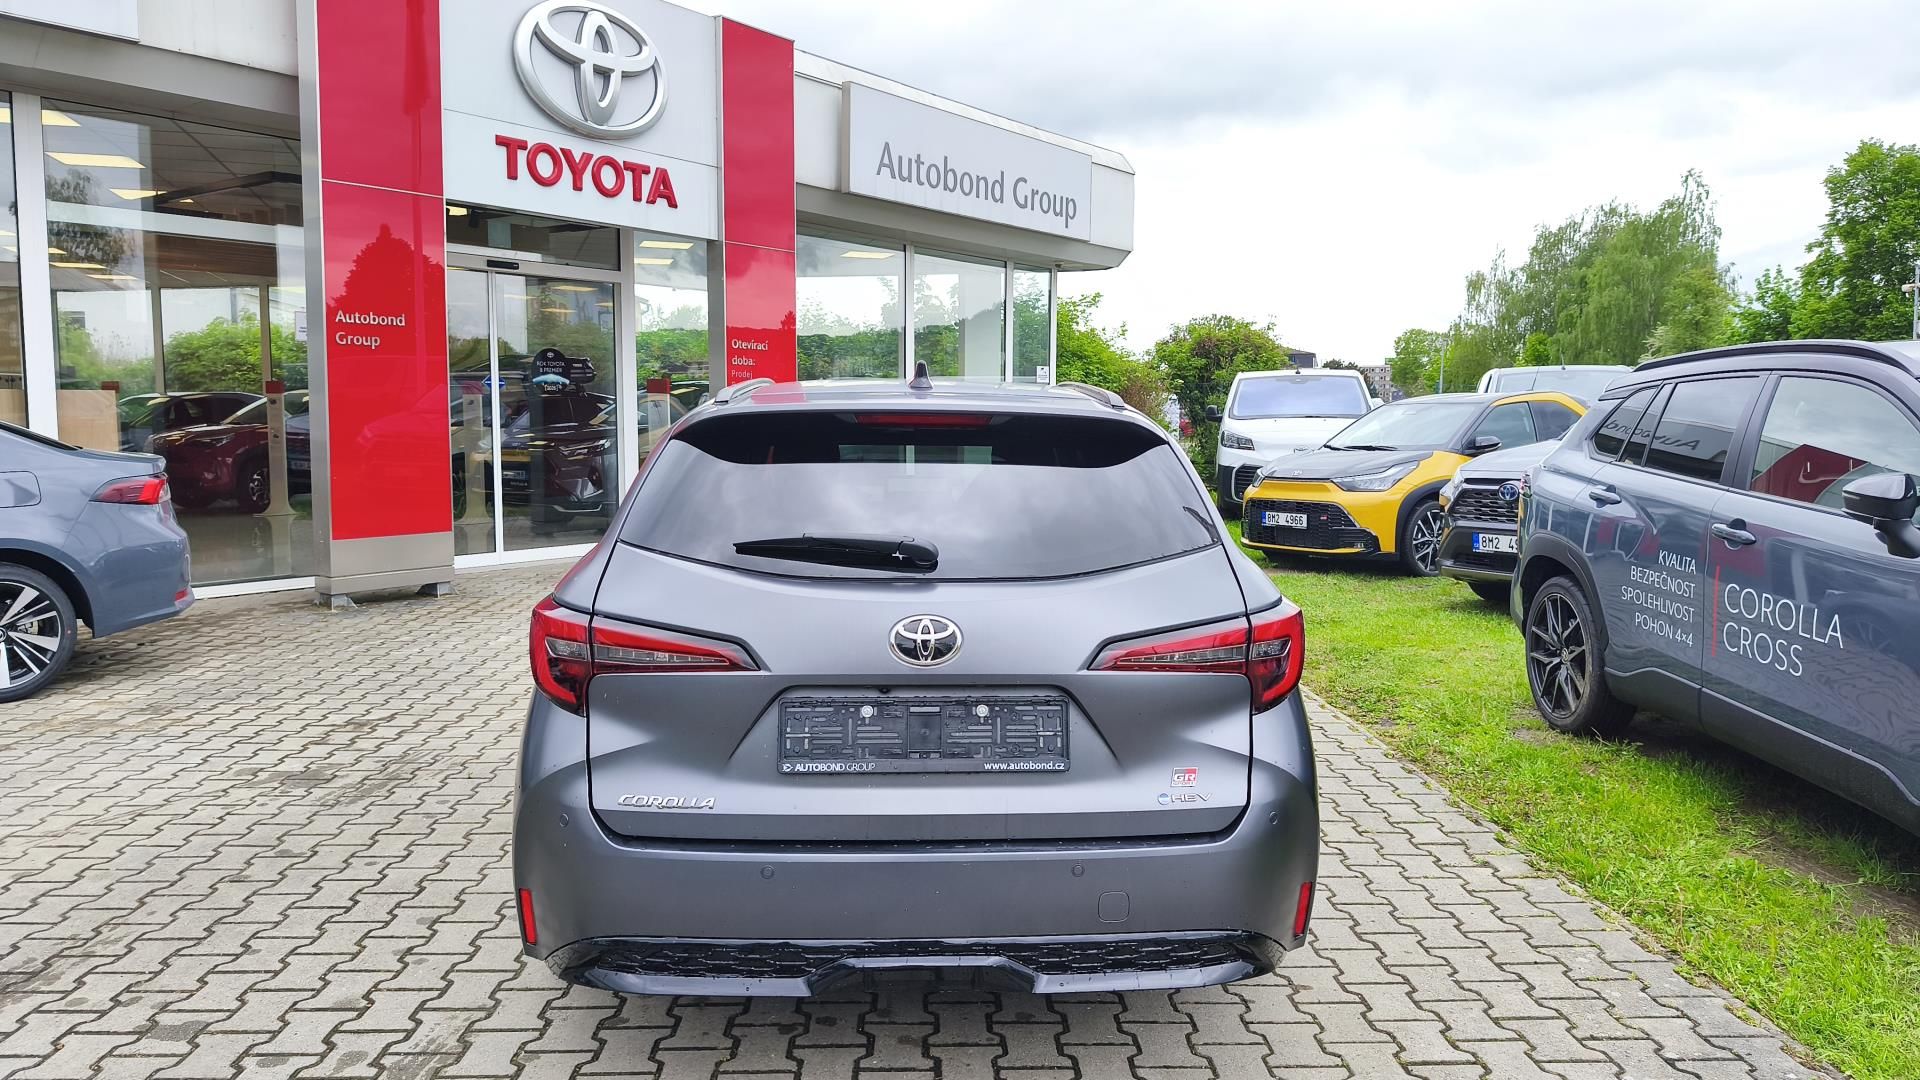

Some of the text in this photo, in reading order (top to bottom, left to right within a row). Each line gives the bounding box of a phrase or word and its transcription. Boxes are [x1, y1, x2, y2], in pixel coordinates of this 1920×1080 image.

[494, 134, 679, 210] TOYOTA
[876, 141, 1078, 229] Autobond Group
[335, 309, 406, 327] Autobond
[335, 331, 381, 350] Group
[731, 338, 769, 351] Otevírací
[731, 354, 756, 366] doba:
[731, 370, 753, 380] Prodej
[1267, 513, 1304, 526] 8M2 4966
[1481, 535, 1500, 550] 8M2
[1658, 549, 1697, 575] KVALITA
[1630, 565, 1696, 599] BEZPEČNOST
[1621, 585, 1695, 624] SPOLEHLIVOST
[1724, 583, 1844, 649] COROLLA
[1635, 612, 1673, 640] POHON
[1723, 622, 1803, 677] CROSS
[794, 762, 876, 772] AUTOBOND GROUP
[984, 761, 1065, 770] www.autobond.cz
[1173, 773, 1196, 781] GR
[617, 794, 716, 809] COROLLA
[1170, 792, 1212, 803] HEV
